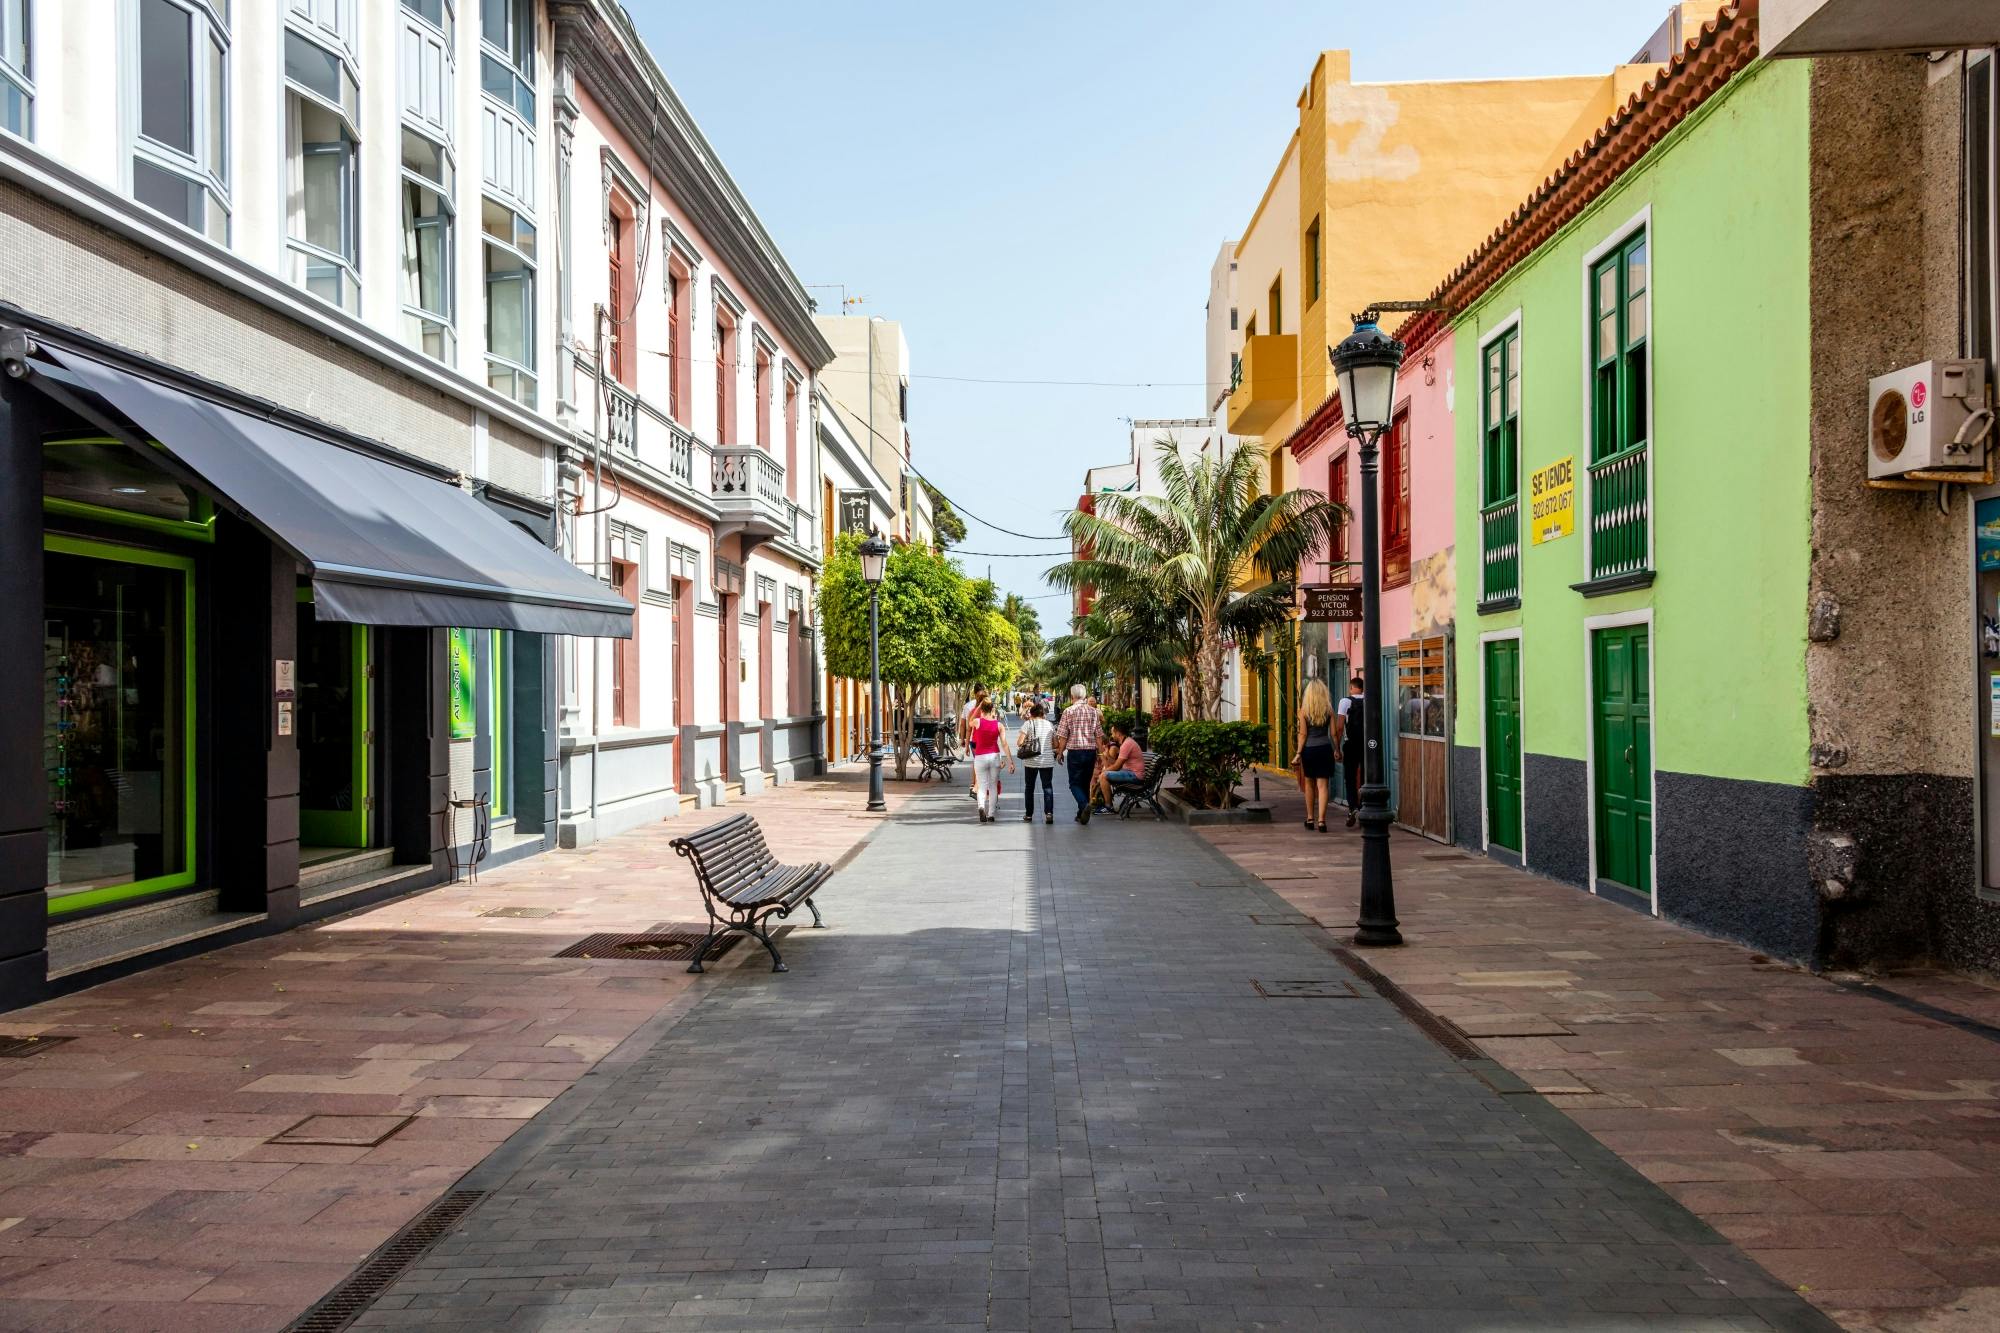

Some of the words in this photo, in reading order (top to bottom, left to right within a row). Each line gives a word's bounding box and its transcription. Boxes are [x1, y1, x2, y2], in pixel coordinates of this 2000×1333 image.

[1912, 411, 1924, 424] LG
[1532, 472, 1543, 496] SE
[1543, 459, 1572, 492] VENDE
[852, 508, 864, 519] LA
[1533, 501, 1545, 520] 922
[1311, 609, 1325, 617] 922
[1328, 609, 1354, 617] 871335
